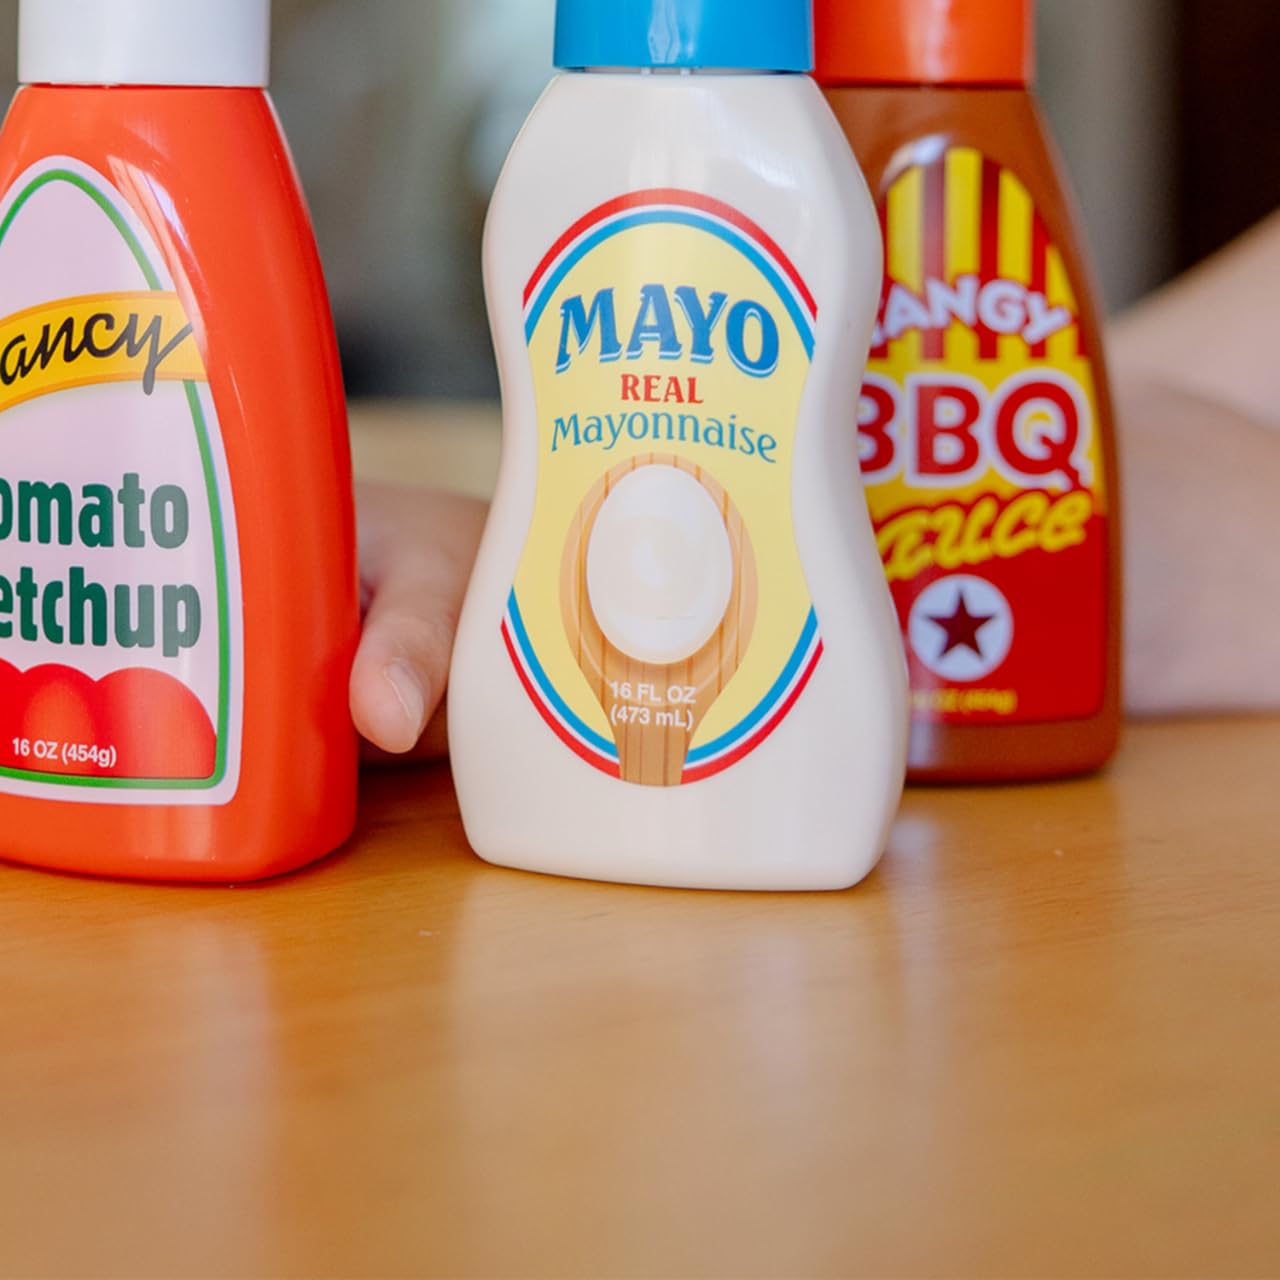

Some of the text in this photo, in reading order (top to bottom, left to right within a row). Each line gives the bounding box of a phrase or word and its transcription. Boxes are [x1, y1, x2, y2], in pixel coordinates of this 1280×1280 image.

[554, 282, 780, 378] MAYO
[869, 273, 1072, 347] ANGY
[619, 373, 704, 405] REAL
[550, 411, 778, 463] Mayonnaise
[857, 370, 1094, 490] BBQ
[876, 491, 1091, 581] auce
[609, 681, 697, 704] 16 FL OZ
[610, 704, 694, 732] (473 mL)
[12, 737, 117, 768] 16 OZ (454g)
